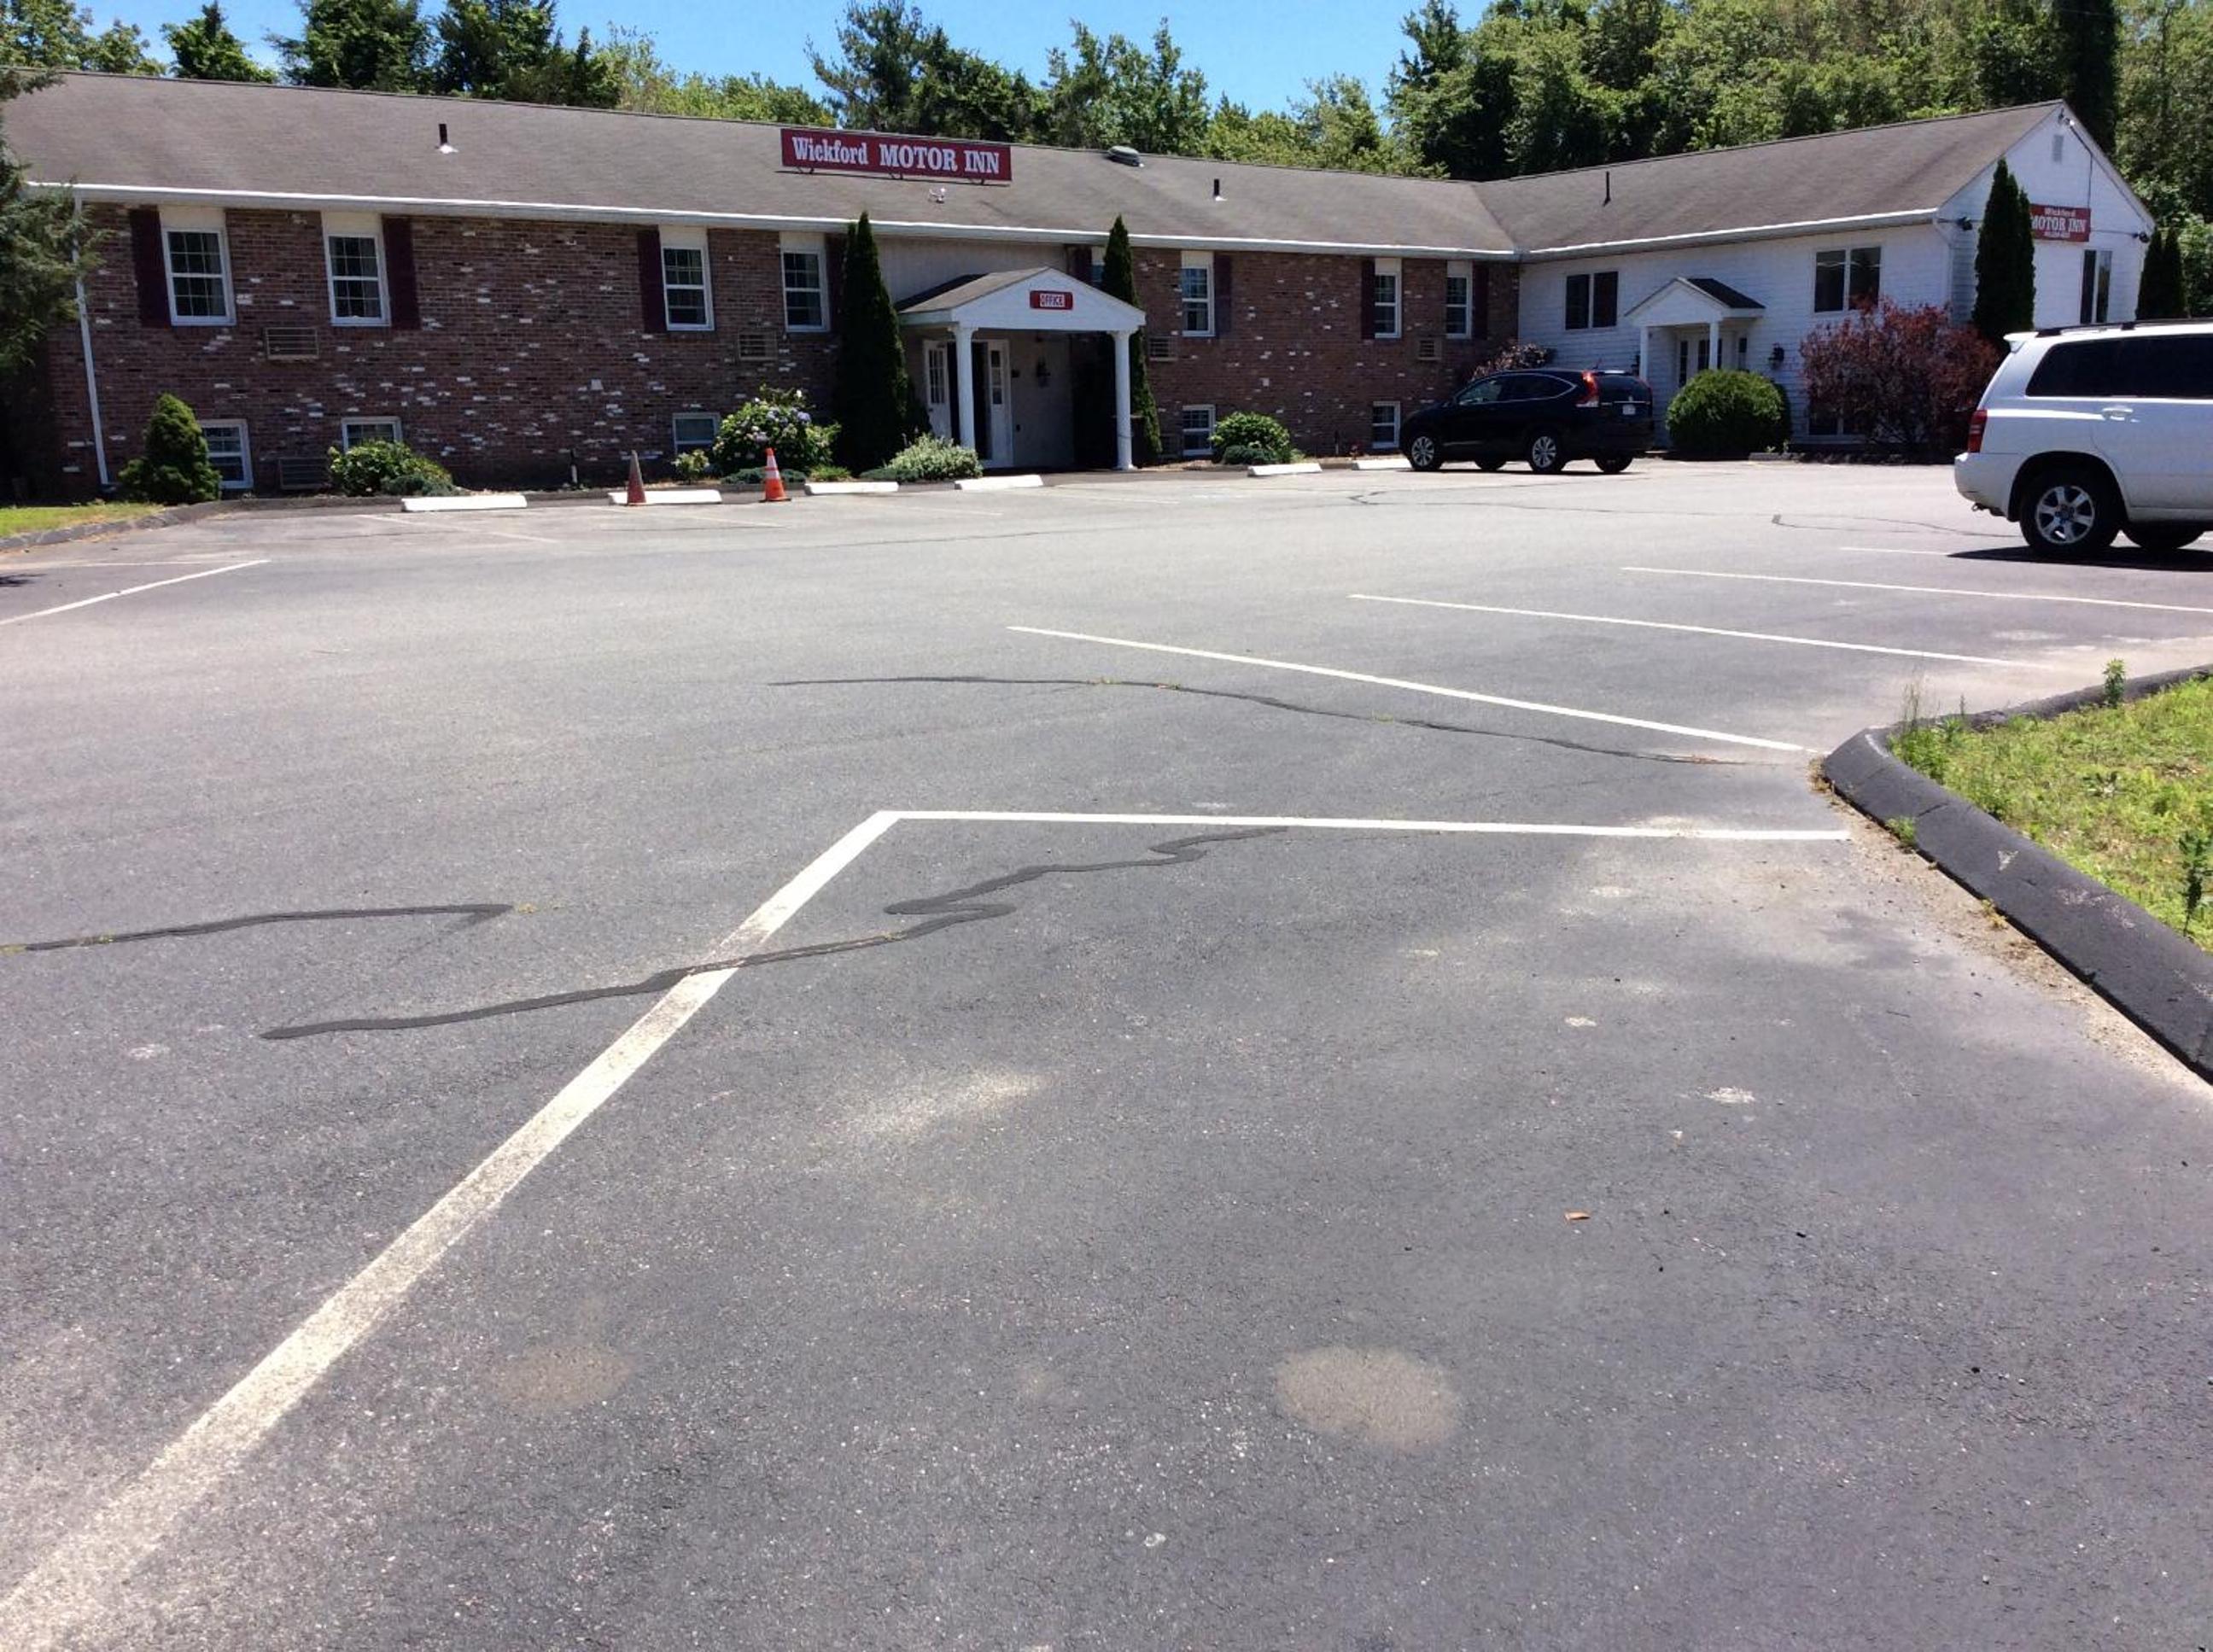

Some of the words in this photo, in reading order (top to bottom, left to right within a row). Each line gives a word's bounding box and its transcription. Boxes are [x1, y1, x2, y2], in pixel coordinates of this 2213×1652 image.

[792, 137, 868, 165] Wickford
[879, 143, 958, 171] MOTOR
[965, 149, 999, 173] INN
[2029, 215, 2066, 231] MOTOR
[2068, 218, 2087, 232] INN
[1040, 293, 1066, 307] OFFICE
